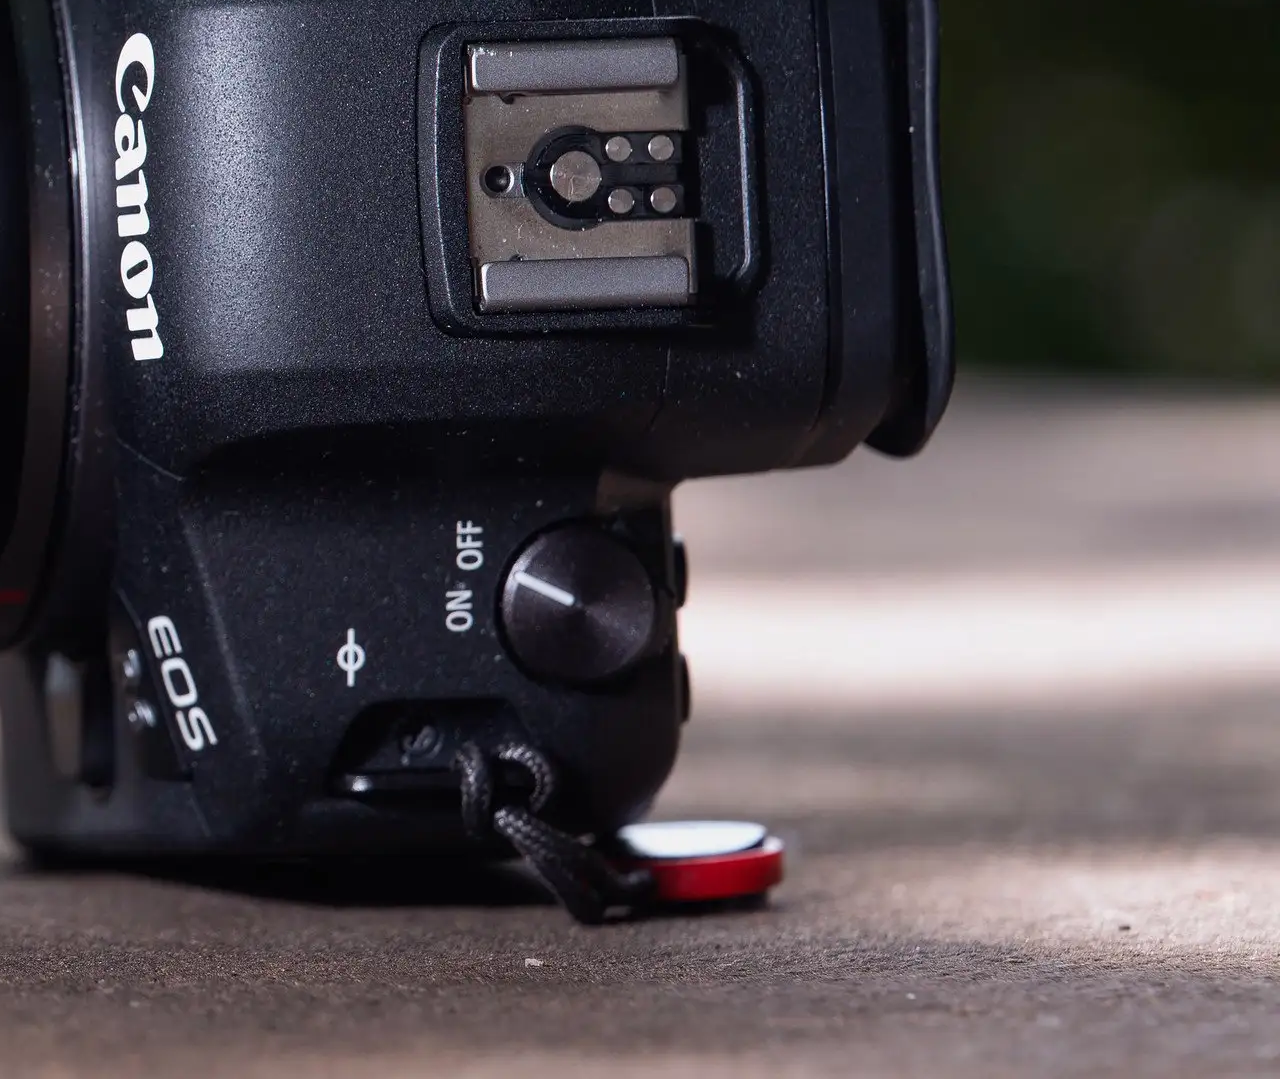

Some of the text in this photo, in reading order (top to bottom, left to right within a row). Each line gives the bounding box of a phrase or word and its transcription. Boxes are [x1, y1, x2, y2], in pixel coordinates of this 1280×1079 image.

[114, 32, 164, 361] Canon
[445, 520, 484, 633] ON OFF
[147, 615, 219, 752] EOS
